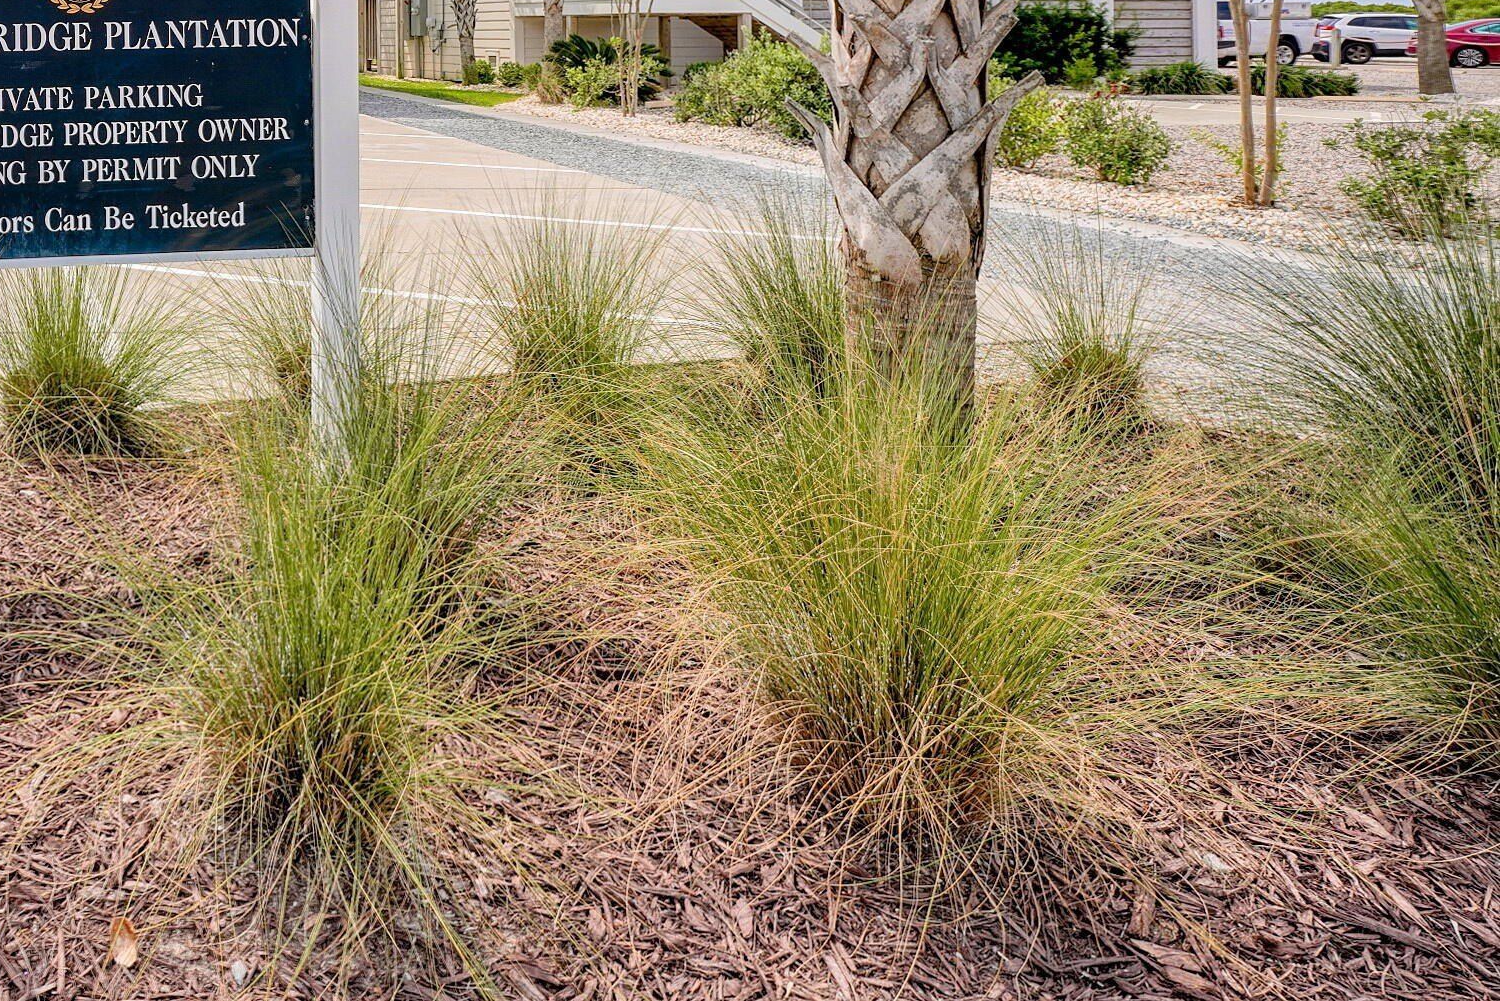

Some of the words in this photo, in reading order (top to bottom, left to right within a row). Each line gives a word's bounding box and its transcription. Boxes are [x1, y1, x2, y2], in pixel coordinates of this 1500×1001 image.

[104, 18, 300, 50] PLANTATION
[84, 83, 204, 110] PARKING
[63, 119, 188, 146] PROPERTY
[198, 117, 291, 143] OWNER
[38, 159, 71, 184] BY
[81, 156, 181, 182] PERMIT
[191, 154, 260, 179] ONLY
[44, 207, 92, 232] Can
[103, 206, 135, 230] Be
[145, 201, 246, 229] Ticketed
